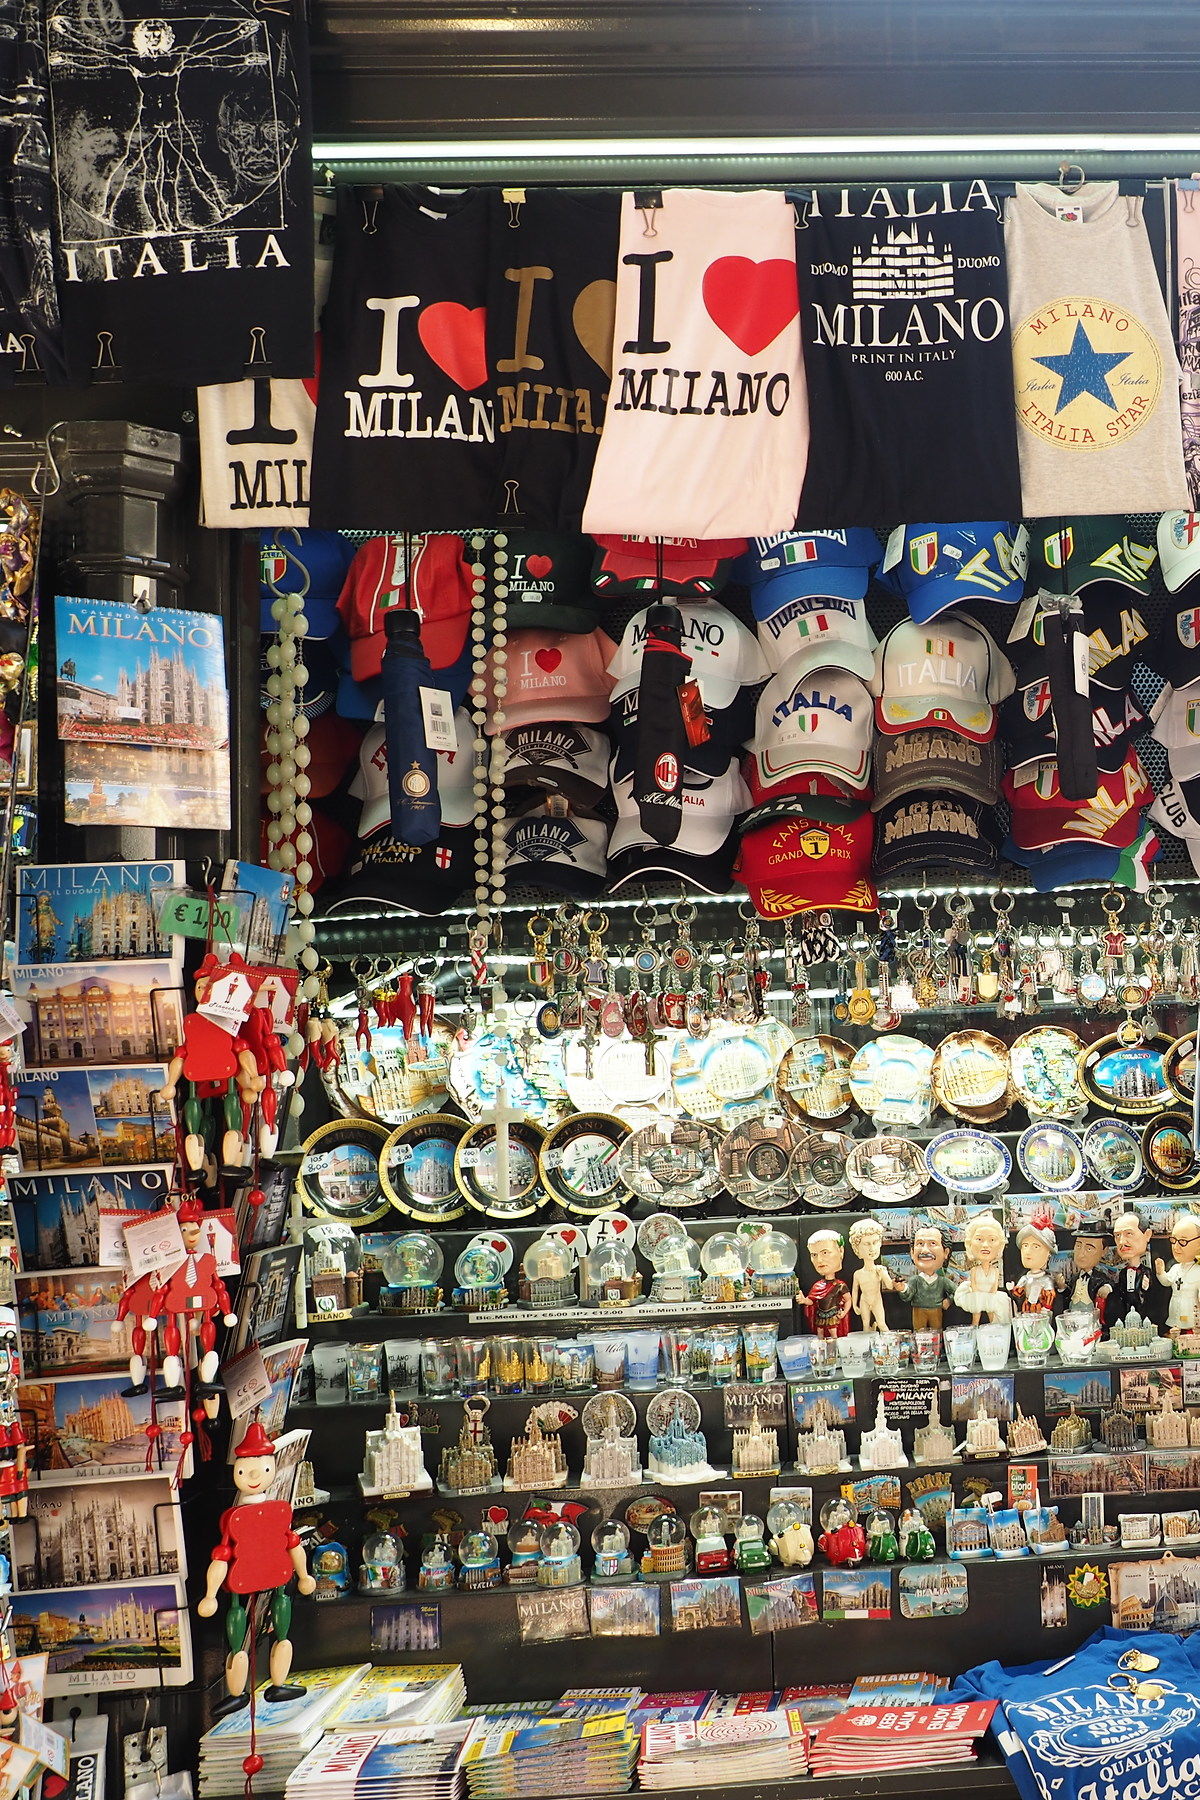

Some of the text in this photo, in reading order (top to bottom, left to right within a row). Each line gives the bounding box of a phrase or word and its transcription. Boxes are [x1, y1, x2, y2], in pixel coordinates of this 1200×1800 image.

[62, 235, 290, 282] ITALIA
[958, 257, 1000, 269] DUOMO
[811, 263, 848, 276] DUOMO
[623, 250, 673, 354] I
[497, 267, 554, 373] I
[811, 298, 1004, 346] MILANO
[1030, 304, 1130, 336] MILANO
[359, 296, 420, 387] I
[851, 350, 955, 364] PRINT IN ITALY
[885, 371, 902, 381] 600
[1022, 395, 1150, 445] ITALIA STAR
[509, 581, 554, 592] MILANO
[69, 614, 212, 647] MILANO
[520, 676, 566, 688] MILANO
[900, 664, 978, 691] ITALIA
[772, 691, 852, 727] ITALIA
[517, 731, 574, 751] MILANO
[1161, 782, 1187, 828] CLUB
[515, 823, 570, 841] MILANO
[769, 849, 851, 864] GRAND PRIX
[21, 865, 173, 889] MILANO
[174, 904, 231, 930] € 1,00
[14, 967, 64, 978] MILANO
[14, 1173, 162, 1195] MILANO
[46, 1310, 118, 1323] MILANO
[313, 1311, 345, 1320] MILANO
[726, 1393, 784, 1406] MILANO
[896, 1392, 934, 1400] MILANO
[75, 1467, 142, 1478] MILANO
[459, 1487, 485, 1495] MILANO
[1012, 1482, 1032, 1490] blond
[520, 1598, 585, 1616] MILANO
[69, 1671, 136, 1682] MILANO
[862, 1673, 920, 1684] MILANO
[790, 1684, 851, 1692] MILANO
[1101, 1728, 1149, 1744] BRAND
[1100, 1740, 1173, 1782] QUALITY
